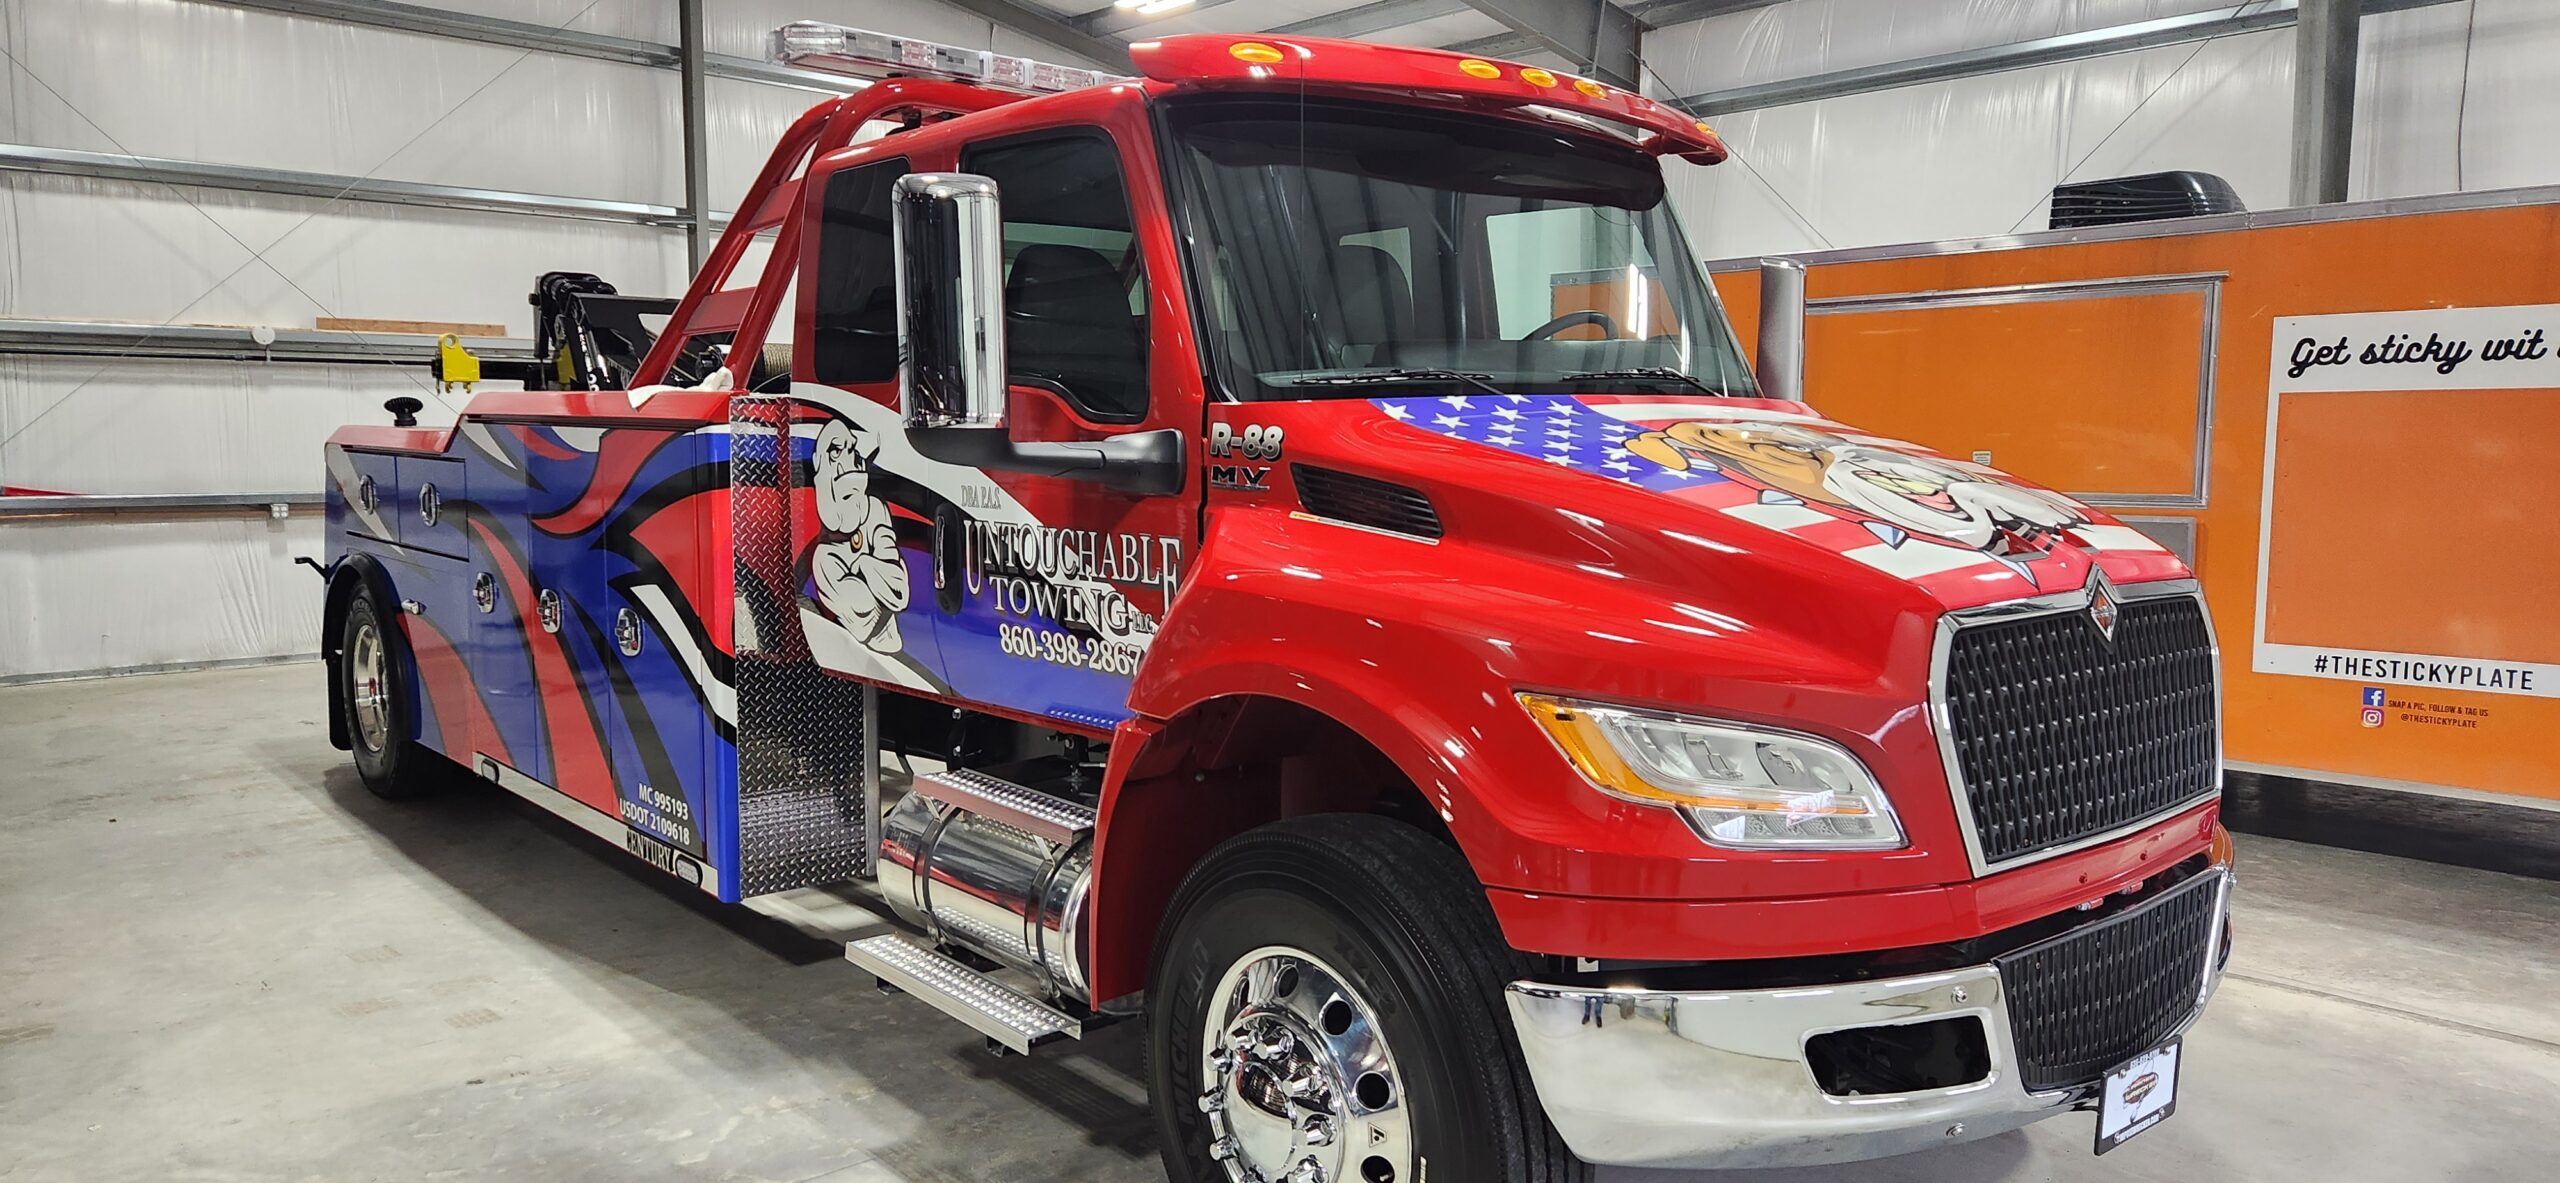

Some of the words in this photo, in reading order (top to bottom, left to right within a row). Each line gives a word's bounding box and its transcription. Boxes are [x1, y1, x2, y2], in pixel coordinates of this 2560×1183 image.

[2288, 336, 2351, 379] Get
[2359, 333, 2473, 375] sticky
[2481, 329, 2548, 361] wit
[1210, 421, 1285, 461] R-88
[1210, 464, 1272, 490] MV
[963, 519, 1182, 619] UNTOUCHABLE
[988, 575, 1130, 633] TOWING
[998, 623, 1143, 677] 860-398-2867
[2313, 654, 2534, 690] #THESTICKYPLATE
[2388, 700, 2406, 709] SNAP
[2407, 701, 2412, 710] A
[2428, 704, 2457, 714] FOLLOW
[2465, 707, 2478, 716] TAG
[2479, 709, 2489, 717] US
[2400, 713, 2477, 729] @THESTICKYPLATE
[619, 798, 649, 826] USDOT
[650, 812, 690, 846] 2109618
[638, 783, 654, 805] MC
[654, 790, 689, 820] 995193
[626, 829, 675, 872] CENTURY
